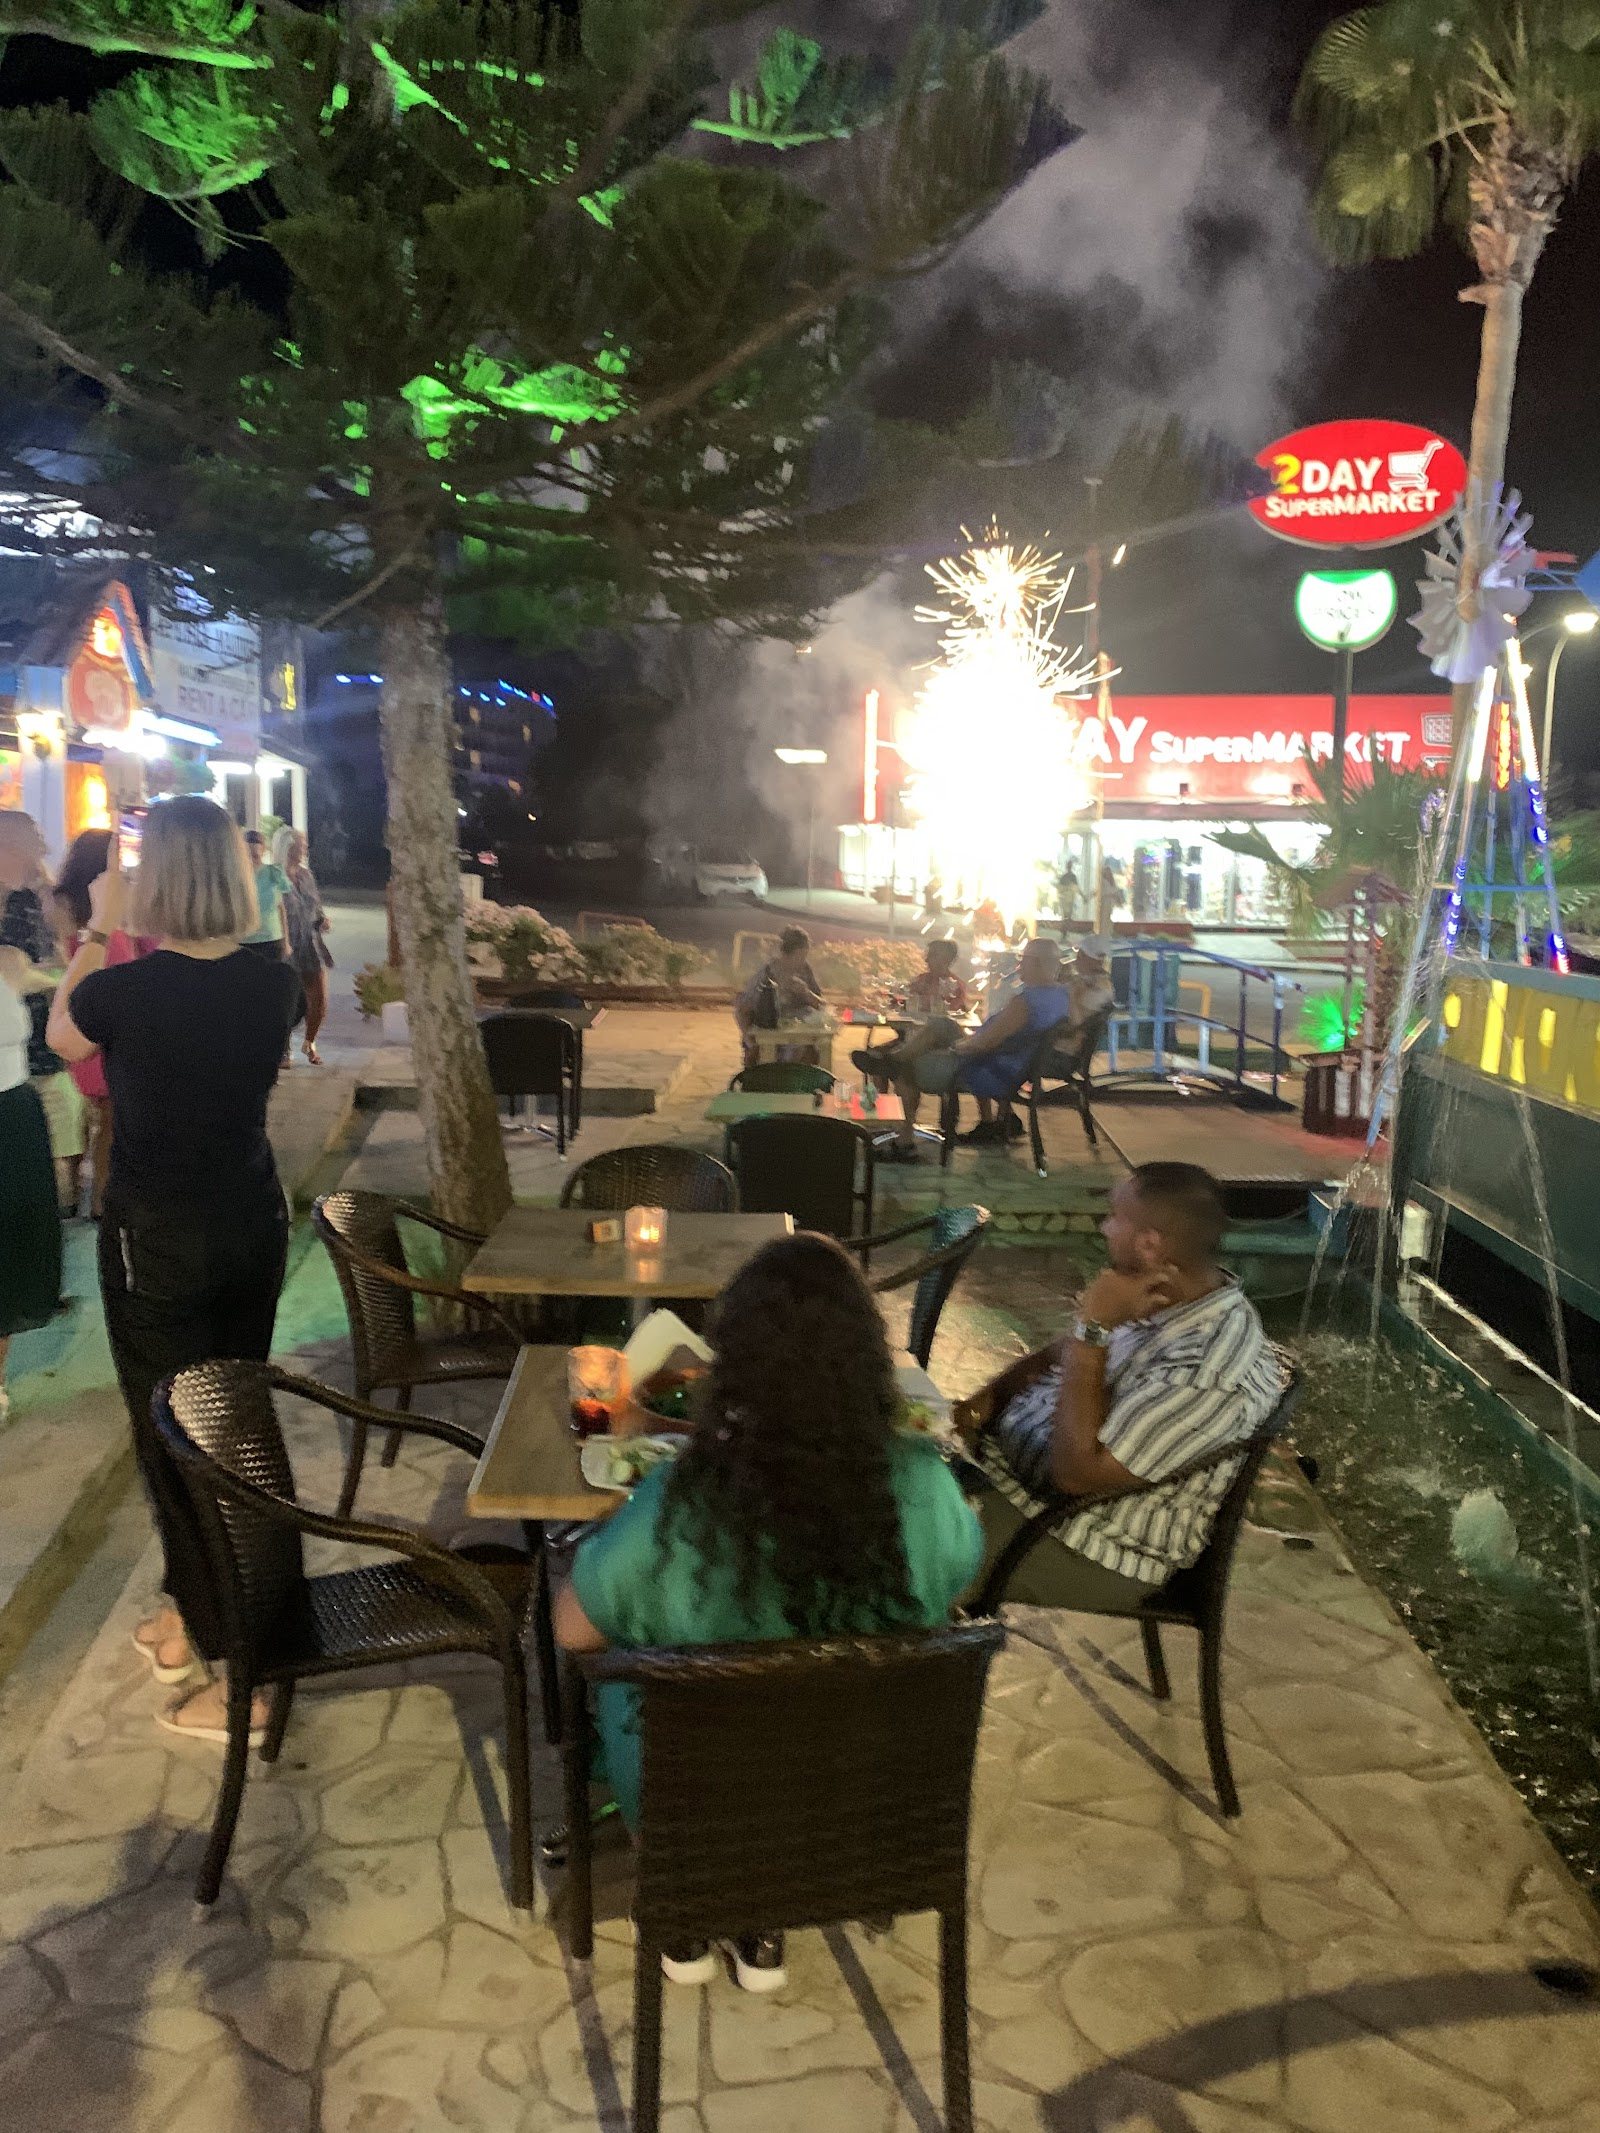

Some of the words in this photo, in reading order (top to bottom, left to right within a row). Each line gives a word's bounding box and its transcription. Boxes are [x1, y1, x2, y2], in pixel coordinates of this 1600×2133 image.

[1273, 453, 1383, 494] 2DAY
[1264, 490, 1440, 519] SUPERMARKET
[1072, 716, 1148, 764] AY
[1150, 731, 1411, 763] SUPERMARKET
